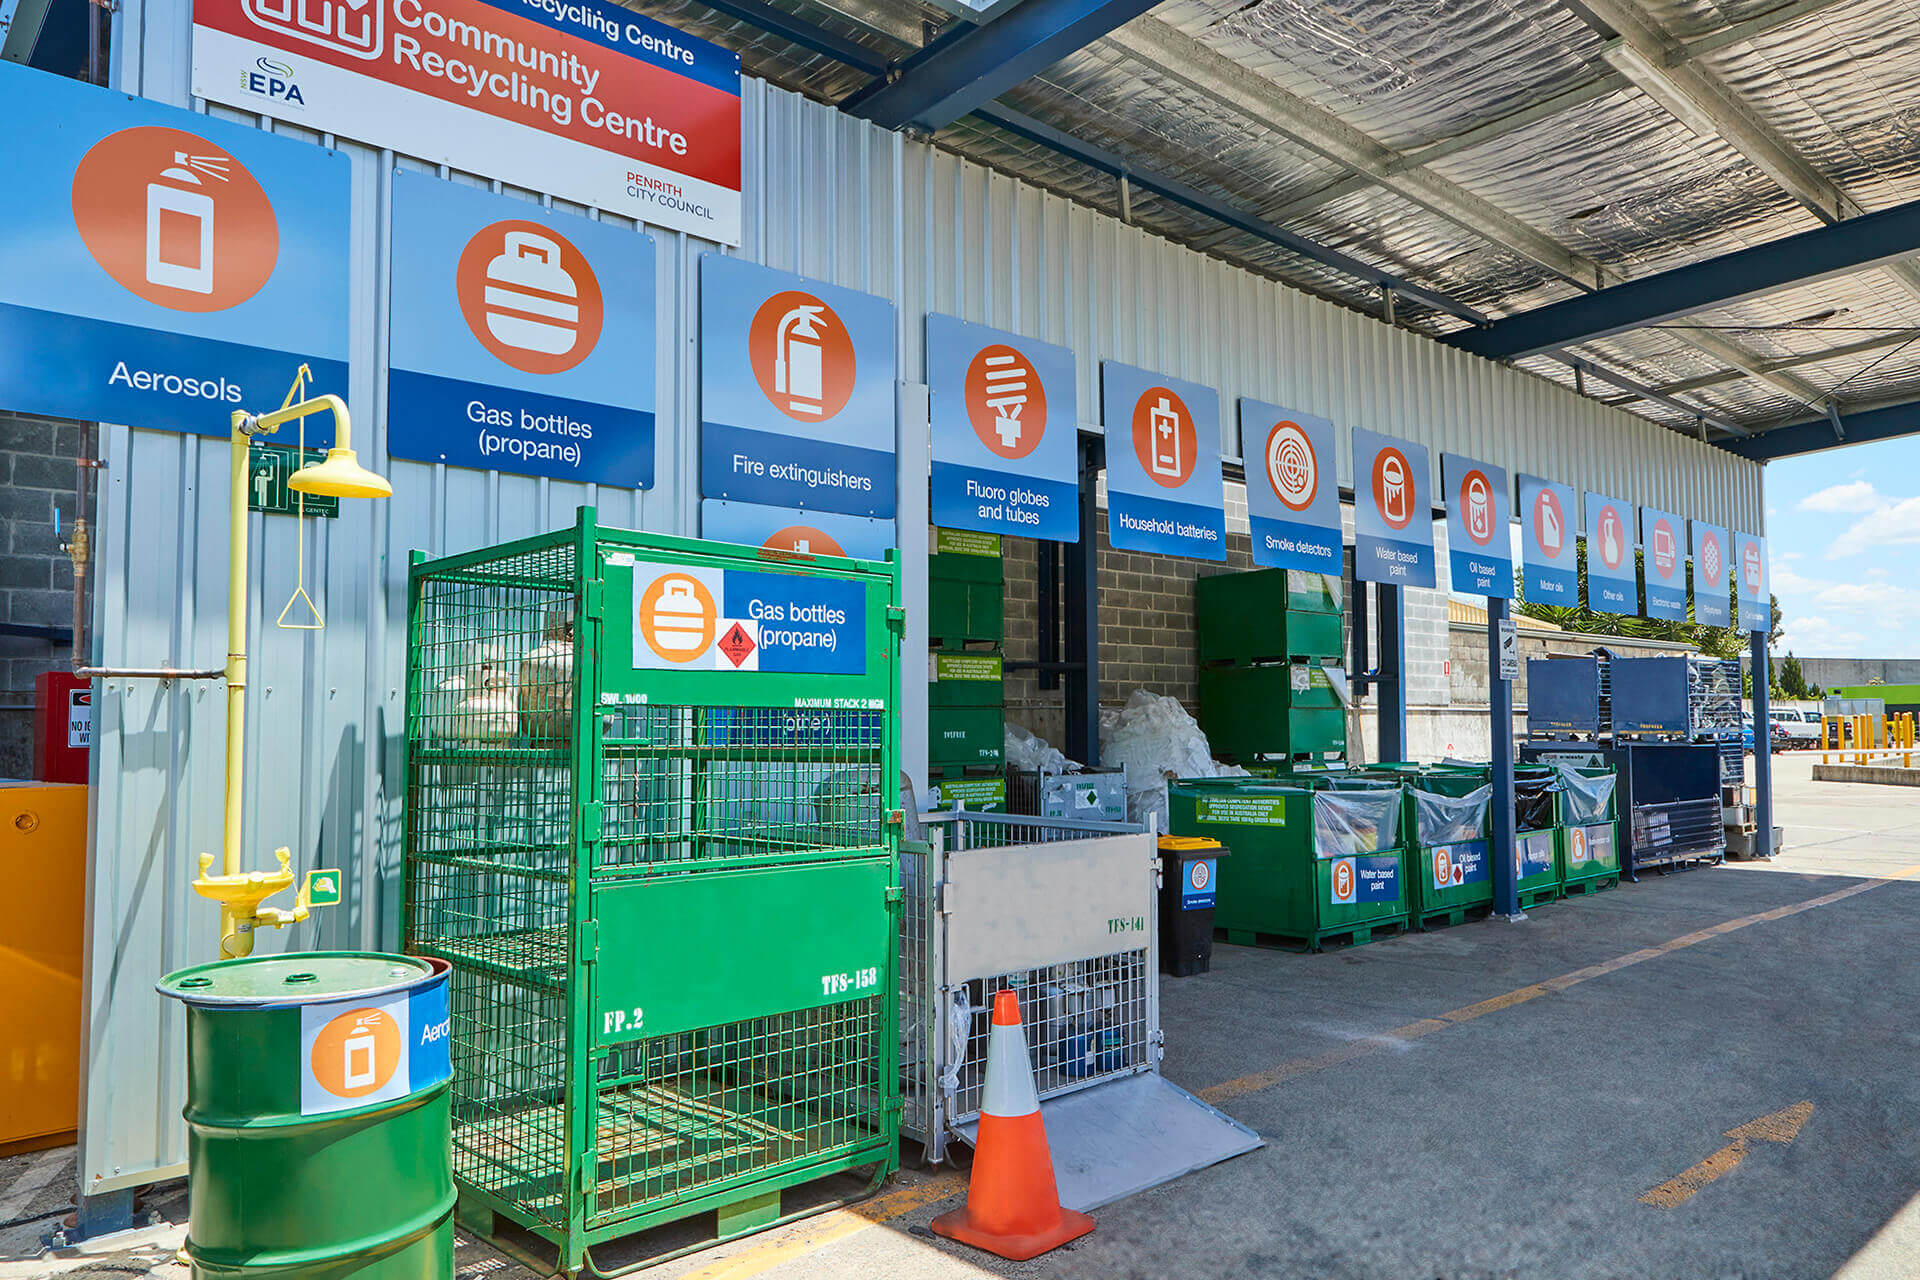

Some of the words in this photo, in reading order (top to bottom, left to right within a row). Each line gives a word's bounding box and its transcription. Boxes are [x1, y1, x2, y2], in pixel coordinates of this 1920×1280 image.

[392, 0, 600, 96] Community
[625, 24, 695, 66] Centre
[249, 72, 305, 105] EPA
[393, 32, 572, 126] Recycling
[580, 97, 688, 156] Centre
[626, 171, 683, 198] PENRITH
[626, 185, 656, 202] CITY
[657, 194, 714, 221] COUNCIL
[108, 361, 242, 403] Aerosols
[467, 400, 513, 427] Gas
[520, 408, 593, 439] bottles
[479, 428, 582, 468] (propane)
[733, 454, 765, 476] Fire
[769, 463, 872, 492] extinguishers
[966, 479, 1006, 501] Fluoro
[1009, 487, 1050, 508] globes
[978, 504, 1003, 520] and
[1005, 506, 1040, 525] tubes
[1119, 512, 1175, 535] Household
[1176, 521, 1218, 541] batteries
[1265, 535, 1295, 552] Smoke
[1295, 540, 1332, 558] detectors
[1375, 546, 1397, 560] Water
[1397, 550, 1418, 564] based
[1389, 564, 1407, 577] paint
[1469, 561, 1478, 573] Oil
[1478, 563, 1496, 576] based
[1476, 577, 1491, 589] paint
[1540, 579, 1555, 591] Motor
[748, 599, 785, 620] Gas
[790, 601, 846, 624] bottles
[758, 624, 837, 653] (propane)
[794, 697, 832, 708] MAXIMUM
[833, 698, 859, 709] STACK
[860, 699, 868, 708] 2
[1459, 854, 1467, 864] Oil
[1467, 852, 1481, 862] based
[1464, 863, 1477, 874] paint
[1360, 869, 1377, 879] Water
[1377, 868, 1394, 879] based
[1370, 881, 1385, 892] paint
[1108, 916, 1144, 935] TFS-141
[822, 967, 877, 996] TFS-158
[421, 1016, 450, 1046] Aero
[603, 1007, 644, 1034] FP.2
